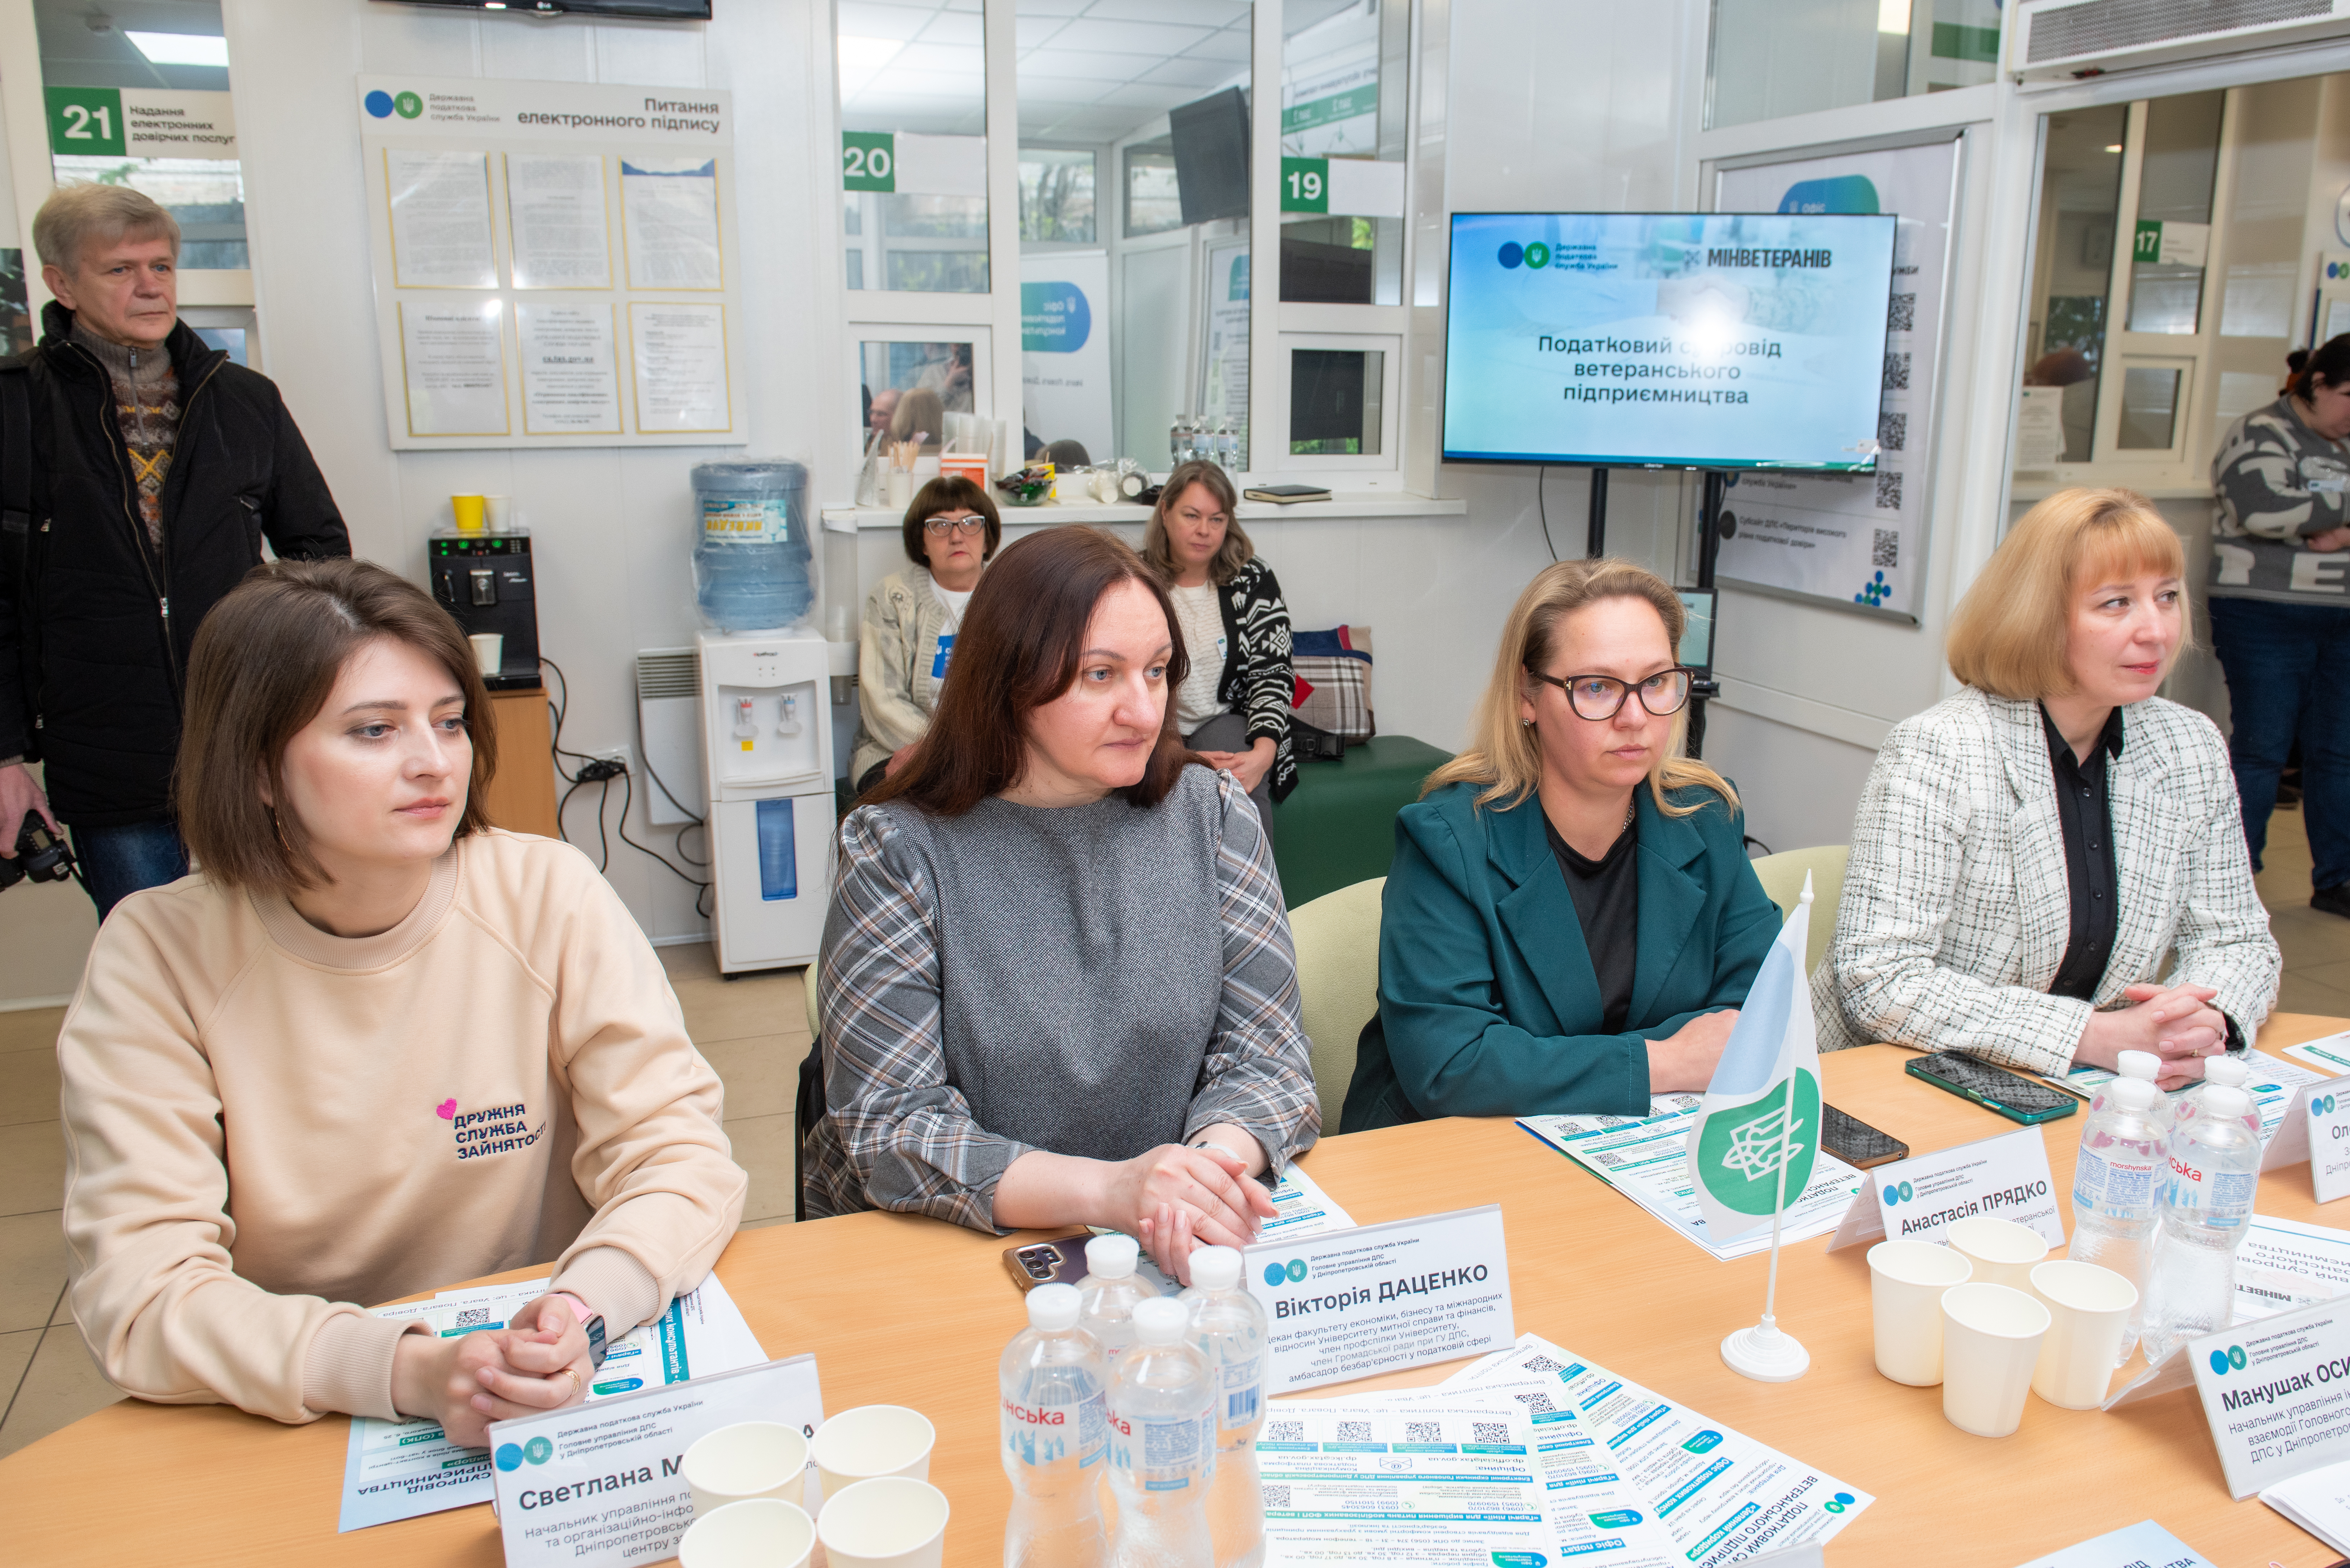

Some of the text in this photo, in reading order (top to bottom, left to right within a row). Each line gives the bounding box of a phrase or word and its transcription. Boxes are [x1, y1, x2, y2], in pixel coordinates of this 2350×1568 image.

[130, 107, 184, 116] Надання
[645, 98, 719, 114] Питання
[63, 105, 112, 140] 21
[131, 120, 213, 130] електронних
[518, 112, 719, 134] електронного підпису
[132, 132, 235, 144] довірчих послуг
[844, 146, 891, 178] 20
[1288, 171, 1322, 200] 19
[2137, 231, 2158, 253] 17
[1707, 248, 1832, 268] МІНВЕТЕРАНІВ
[1539, 336, 1781, 358] Податковий суровід
[1575, 363, 1741, 380] ветеранського
[1564, 384, 1749, 405] підприємництва
[454, 1103, 526, 1130] ДРУЖНЯ
[456, 1121, 528, 1143] СЛУЖБА
[1913, 1159, 1987, 1183] Державна податкова служба України
[2110, 1162, 2152, 1171] morshynska
[1915, 1174, 1964, 1192] Головне управління ДПС
[1920, 1177, 1973, 1197] Дніпропетровській області
[1901, 1180, 2047, 1236] Анастасія ПРЯДКО
[1311, 1238, 1419, 1262] Державна податкова служба України
[1312, 1253, 1384, 1271] Головне управління ДПС
[1318, 1263, 1373, 1278] Дніпропетровській
[1375, 1258, 1396, 1267] області
[1275, 1264, 1488, 1319] Вікторія ДАЦЕНКО
[383, 1308, 417, 1317] Довіра
[420, 1302, 457, 1311] Повага.
[1295, 1322, 1348, 1339] факультету
[1350, 1314, 1398, 1329] економіки,
[1401, 1306, 1433, 1321] бізнесу
[1436, 1303, 1445, 1312] та
[1447, 1293, 1503, 1311] міжнародних
[1274, 1305, 1496, 1353] відносин Університету митної справи та фінансів,
[1319, 1321, 1460, 1355] член профспілки Університету,
[2246, 1318, 2333, 1348] Державна податкова служба України
[611, 1351, 639, 1359] «Гарячі
[665, 1323, 682, 1374] консультантів
[1311, 1329, 1469, 1367] член Громадської ради при ГУ ДПС,
[2249, 1336, 2308, 1357] Головне управління ДПС
[2255, 1346, 2301, 1364] Дніпропетровській
[2301, 1341, 2320, 1352] області
[1289, 1368, 1340, 1383] амбасадор
[1417, 1342, 1465, 1357] податковій
[1466, 1335, 1492, 1350] сфері
[2221, 1372, 2314, 1412] Манушак
[558, 1400, 703, 1439] Державна податкова служба України
[2229, 1393, 2342, 1435] Начальник управління
[559, 1422, 656, 1450] Головне управління ДПС
[2248, 1407, 2350, 1446] взаємодії Головного
[401, 1433, 435, 1445] (ОПК)
[567, 1434, 642, 1459] Дніпропетровській
[644, 1427, 673, 1439] області
[368, 1456, 425, 1470] контакт-центрі
[390, 1452, 420, 1461] чат-боті
[2251, 1445, 2283, 1464] ДПС у
[406, 1472, 491, 1494] СУПРОВІД
[519, 1465, 653, 1510] Светлана
[1674, 1458, 1729, 1500] Офіс податкових
[1745, 1475, 1818, 1535] ВЕТЕРАНСЬКОГО
[525, 1515, 598, 1539] Начальник
[602, 1495, 676, 1523] управління
[1722, 1503, 1756, 1535] «Зелений
[1744, 1501, 1808, 1554] ПОДАТКОВИЙ
[545, 1537, 560, 1548] та
[623, 1536, 669, 1558] центру
[1689, 1528, 1725, 1559] коридор»
